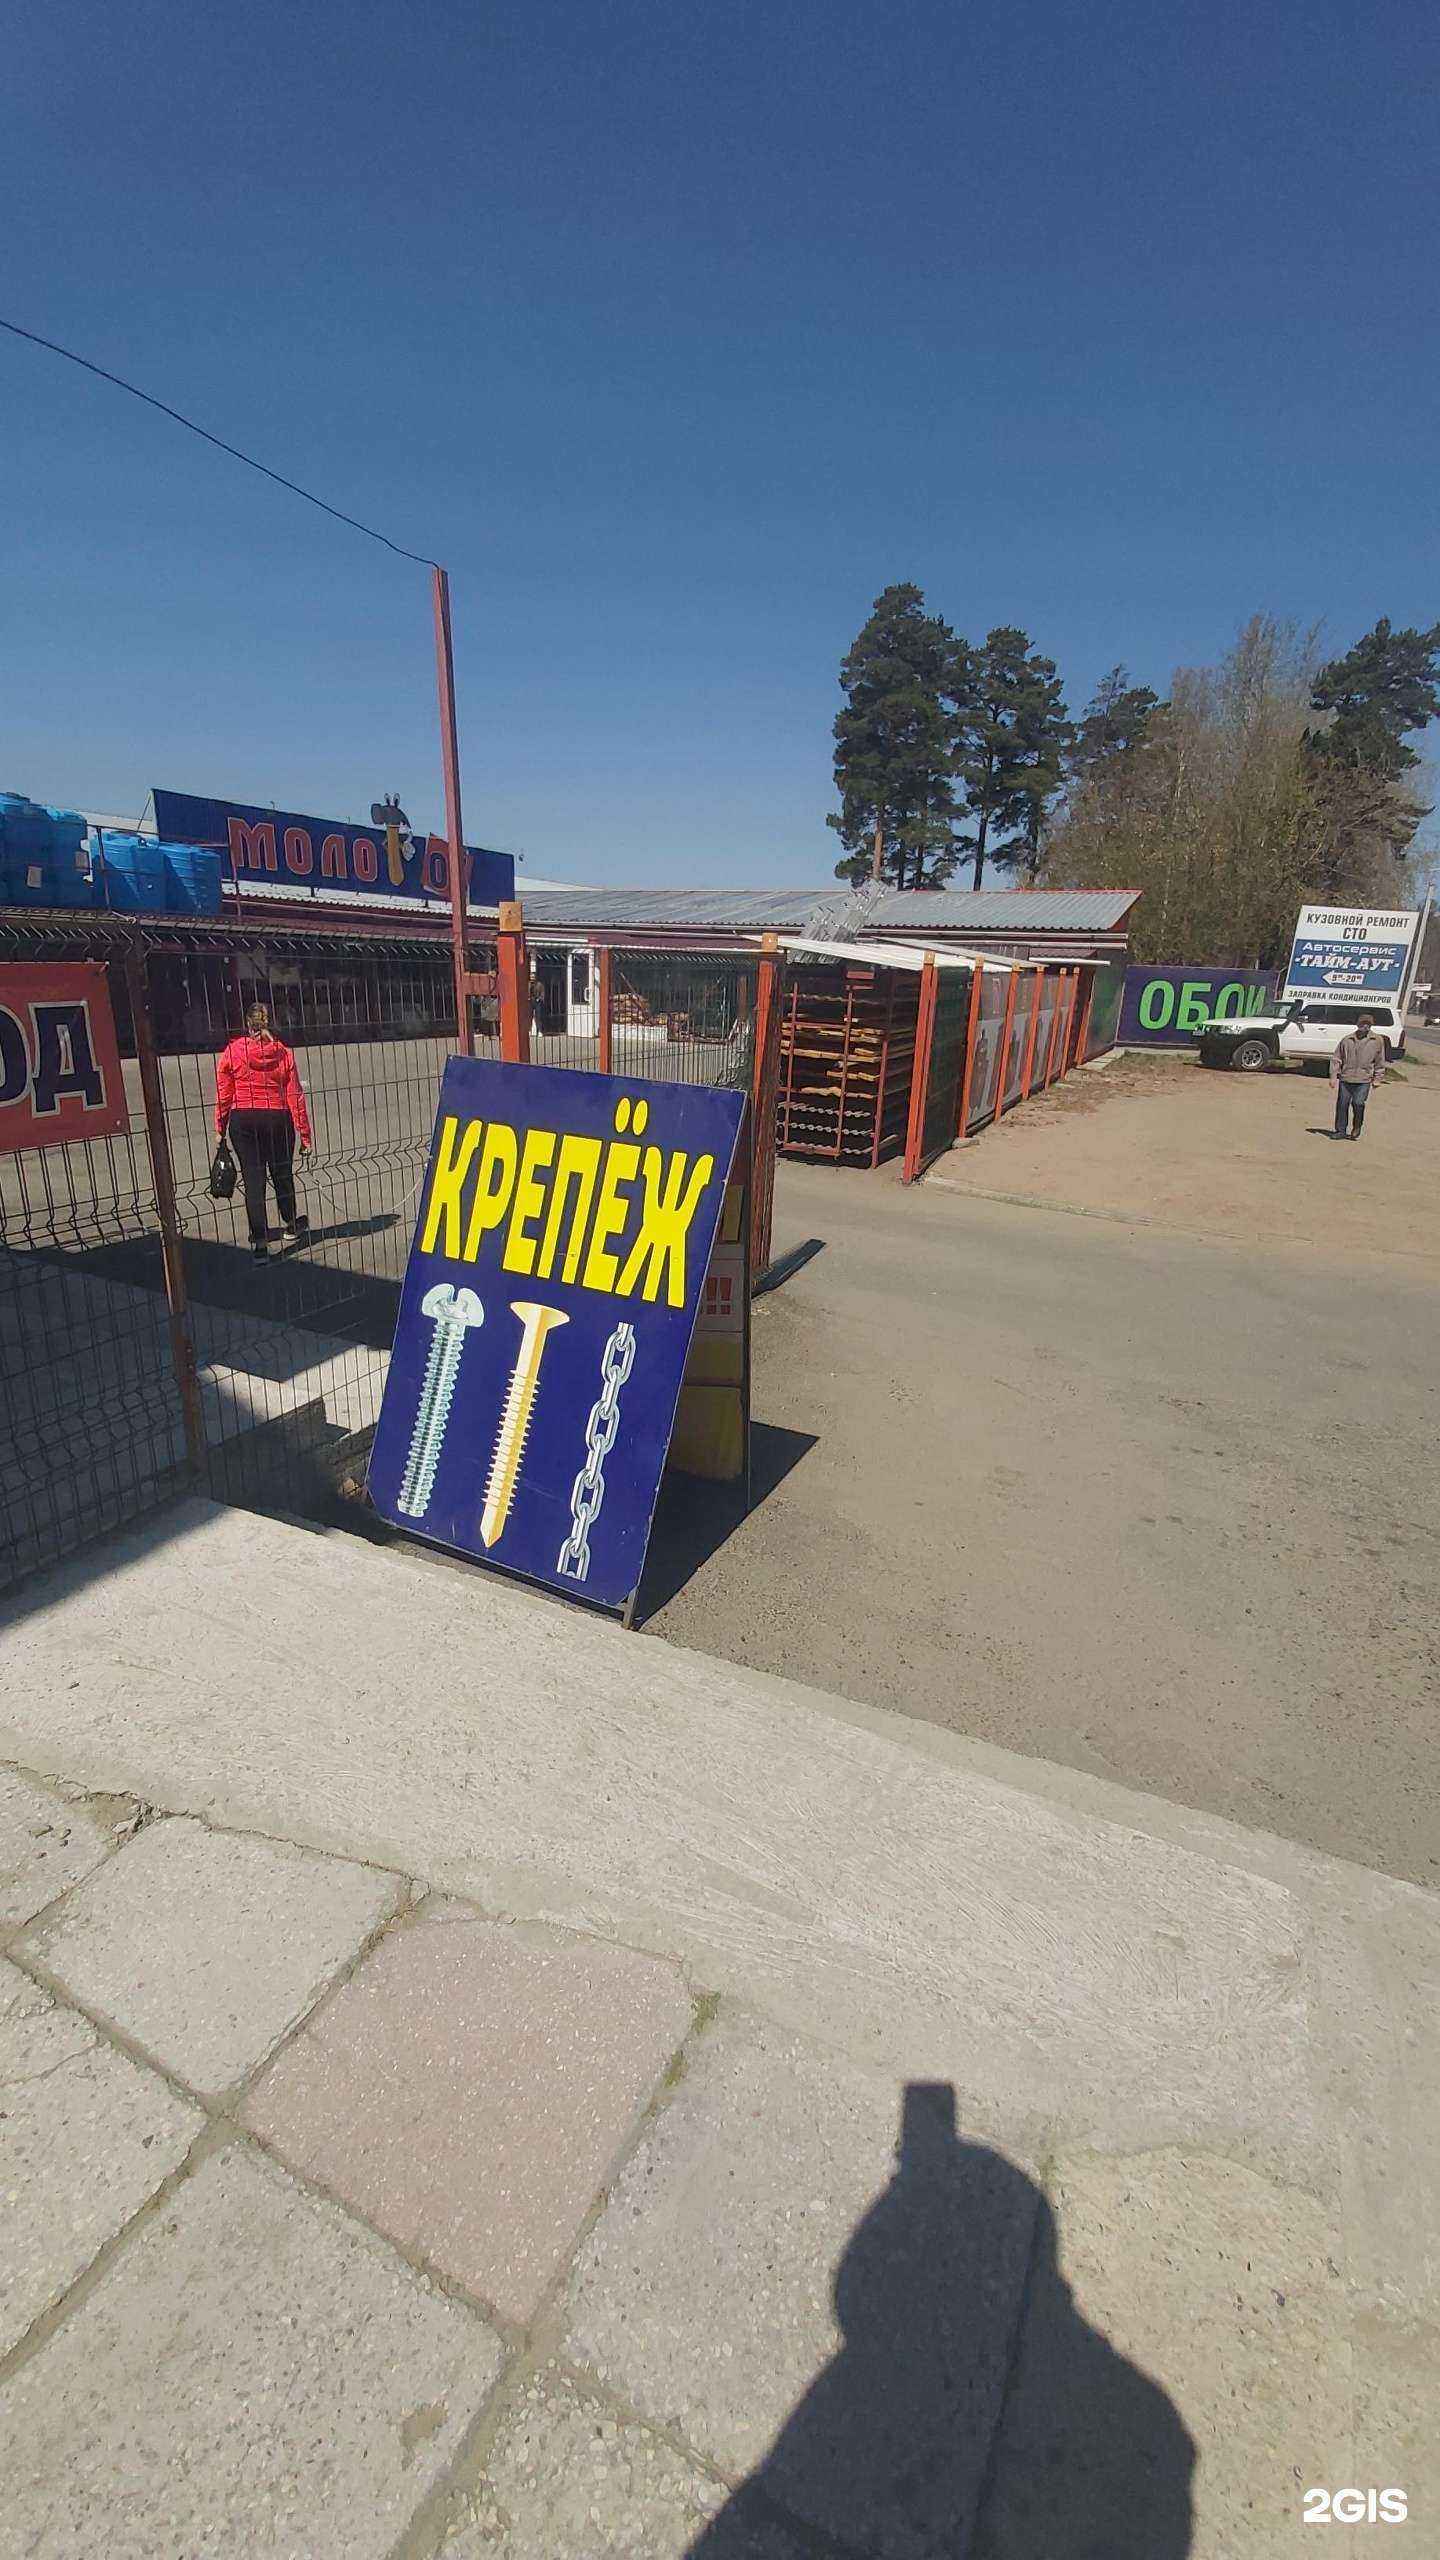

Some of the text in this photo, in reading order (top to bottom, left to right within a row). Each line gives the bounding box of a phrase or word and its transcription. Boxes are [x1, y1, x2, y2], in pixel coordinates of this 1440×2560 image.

[1306, 913, 1410, 928] КУЗОВНОЙ РЕМОНТ
[1343, 927, 1367, 940] СТО
[1302, 942, 1398, 956] Автосервис
[1288, 990, 1327, 1000] ЗАПРАВКА
[1139, 979, 1267, 1030] ОБОИ
[420, 1097, 714, 1309] КРЕПЁЖ
